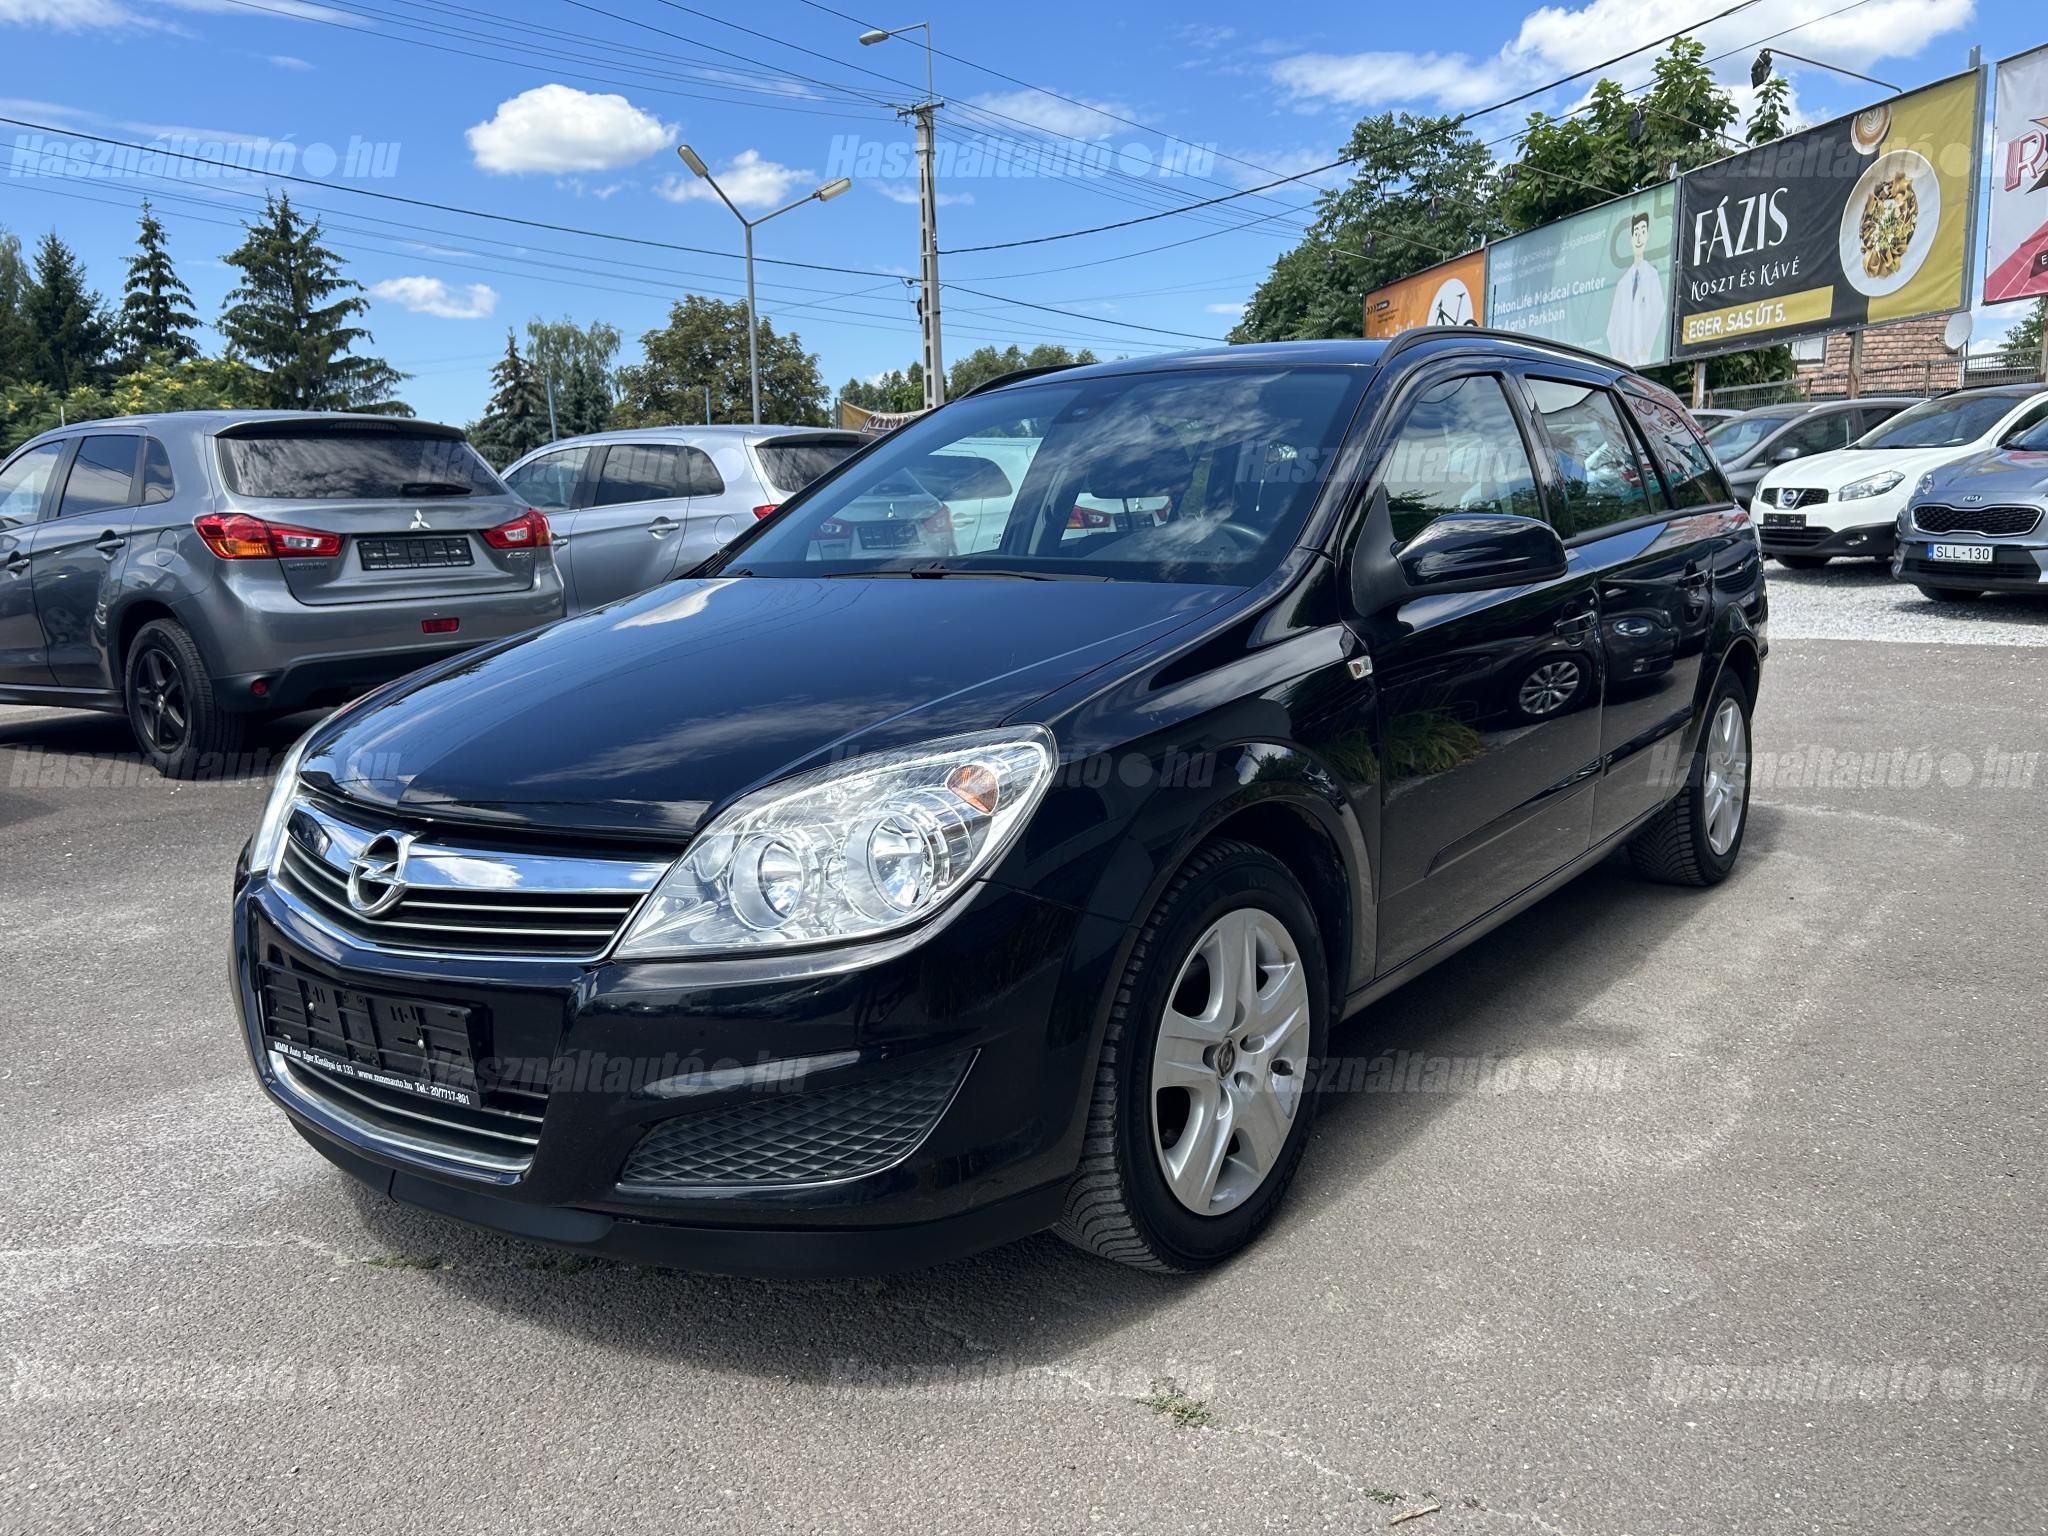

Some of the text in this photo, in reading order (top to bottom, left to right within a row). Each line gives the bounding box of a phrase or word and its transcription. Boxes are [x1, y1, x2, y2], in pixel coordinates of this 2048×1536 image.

[1693, 187, 1789, 267] FÁZIS
[1534, 283, 1570, 305] Medical
[1572, 276, 1606, 295] Center
[1691, 256, 1800, 302] KOSZT ÉS KÁVÉ
[1528, 309, 1566, 327] Parkban
[1688, 302, 1787, 340] EGER, SAS ÚT 5.
[1935, 546, 1990, 560] SLL-130
[289, 1046, 302, 1058] Auto
